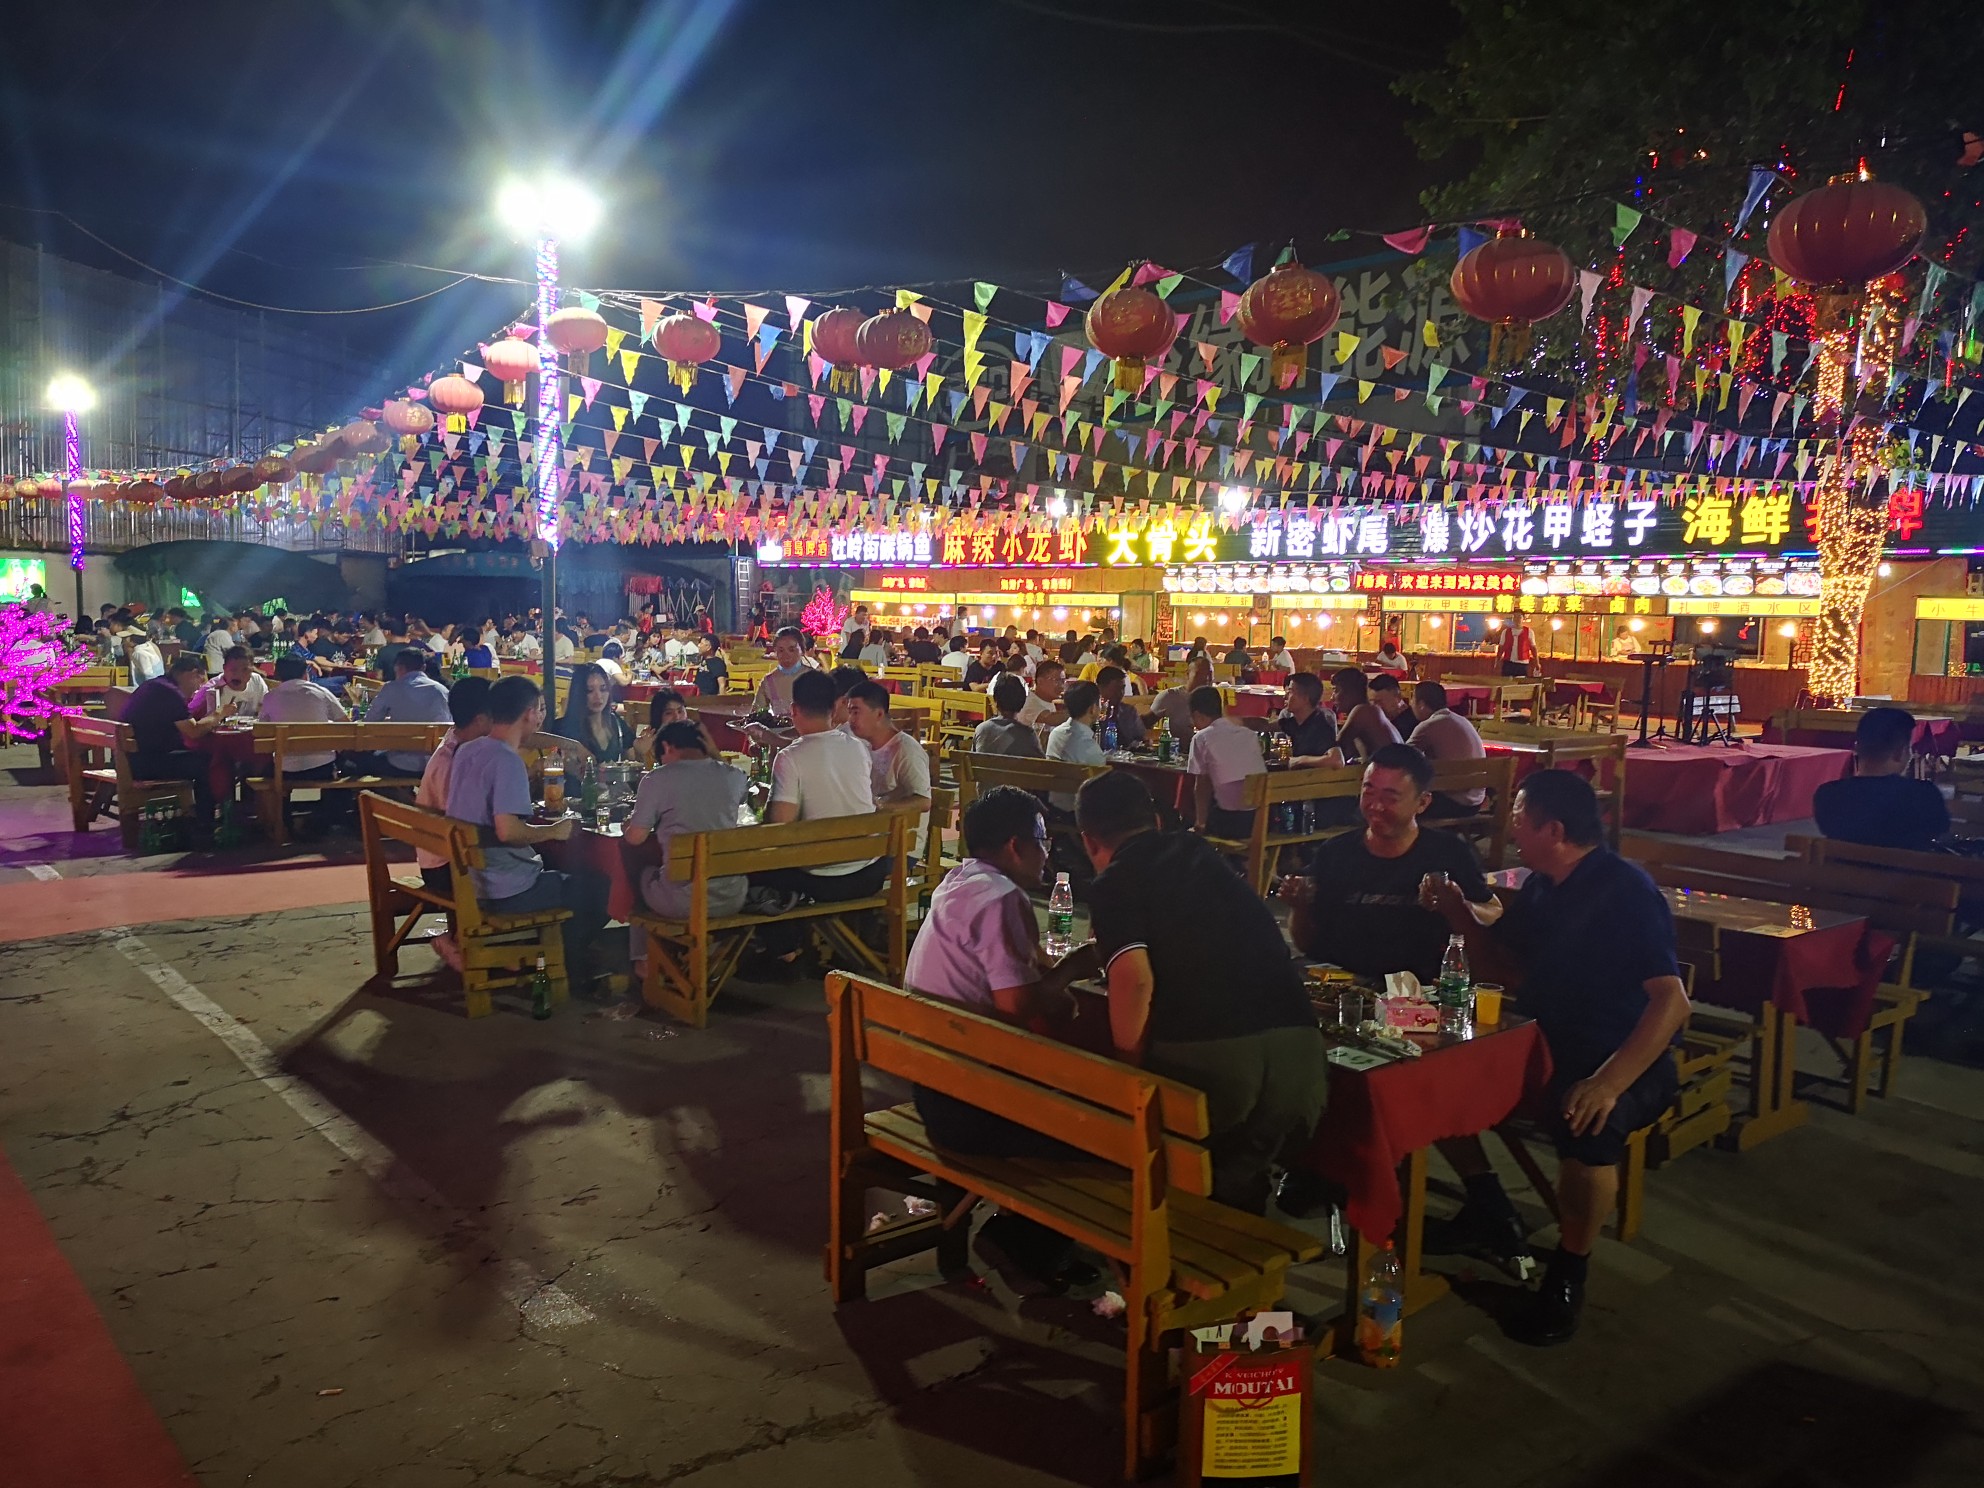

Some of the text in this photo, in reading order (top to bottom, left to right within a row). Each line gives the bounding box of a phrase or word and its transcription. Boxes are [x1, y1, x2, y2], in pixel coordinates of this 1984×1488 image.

[1250, 514, 1390, 558] 新密虾尾
[1421, 500, 1657, 554] 爆炒花甲蛏子
[1682, 496, 1791, 545] 海鲜
[942, 528, 1088, 564] 麻辣小龙虾
[1106, 522, 1218, 564] 大骨头
[1387, 599, 1489, 610] 爆炒花甲蛏子
[1609, 595, 1651, 613] 卤肉
[1679, 601, 1811, 614] 扎啤酒水区
[1213, 1376, 1294, 1395] MOUTAI
